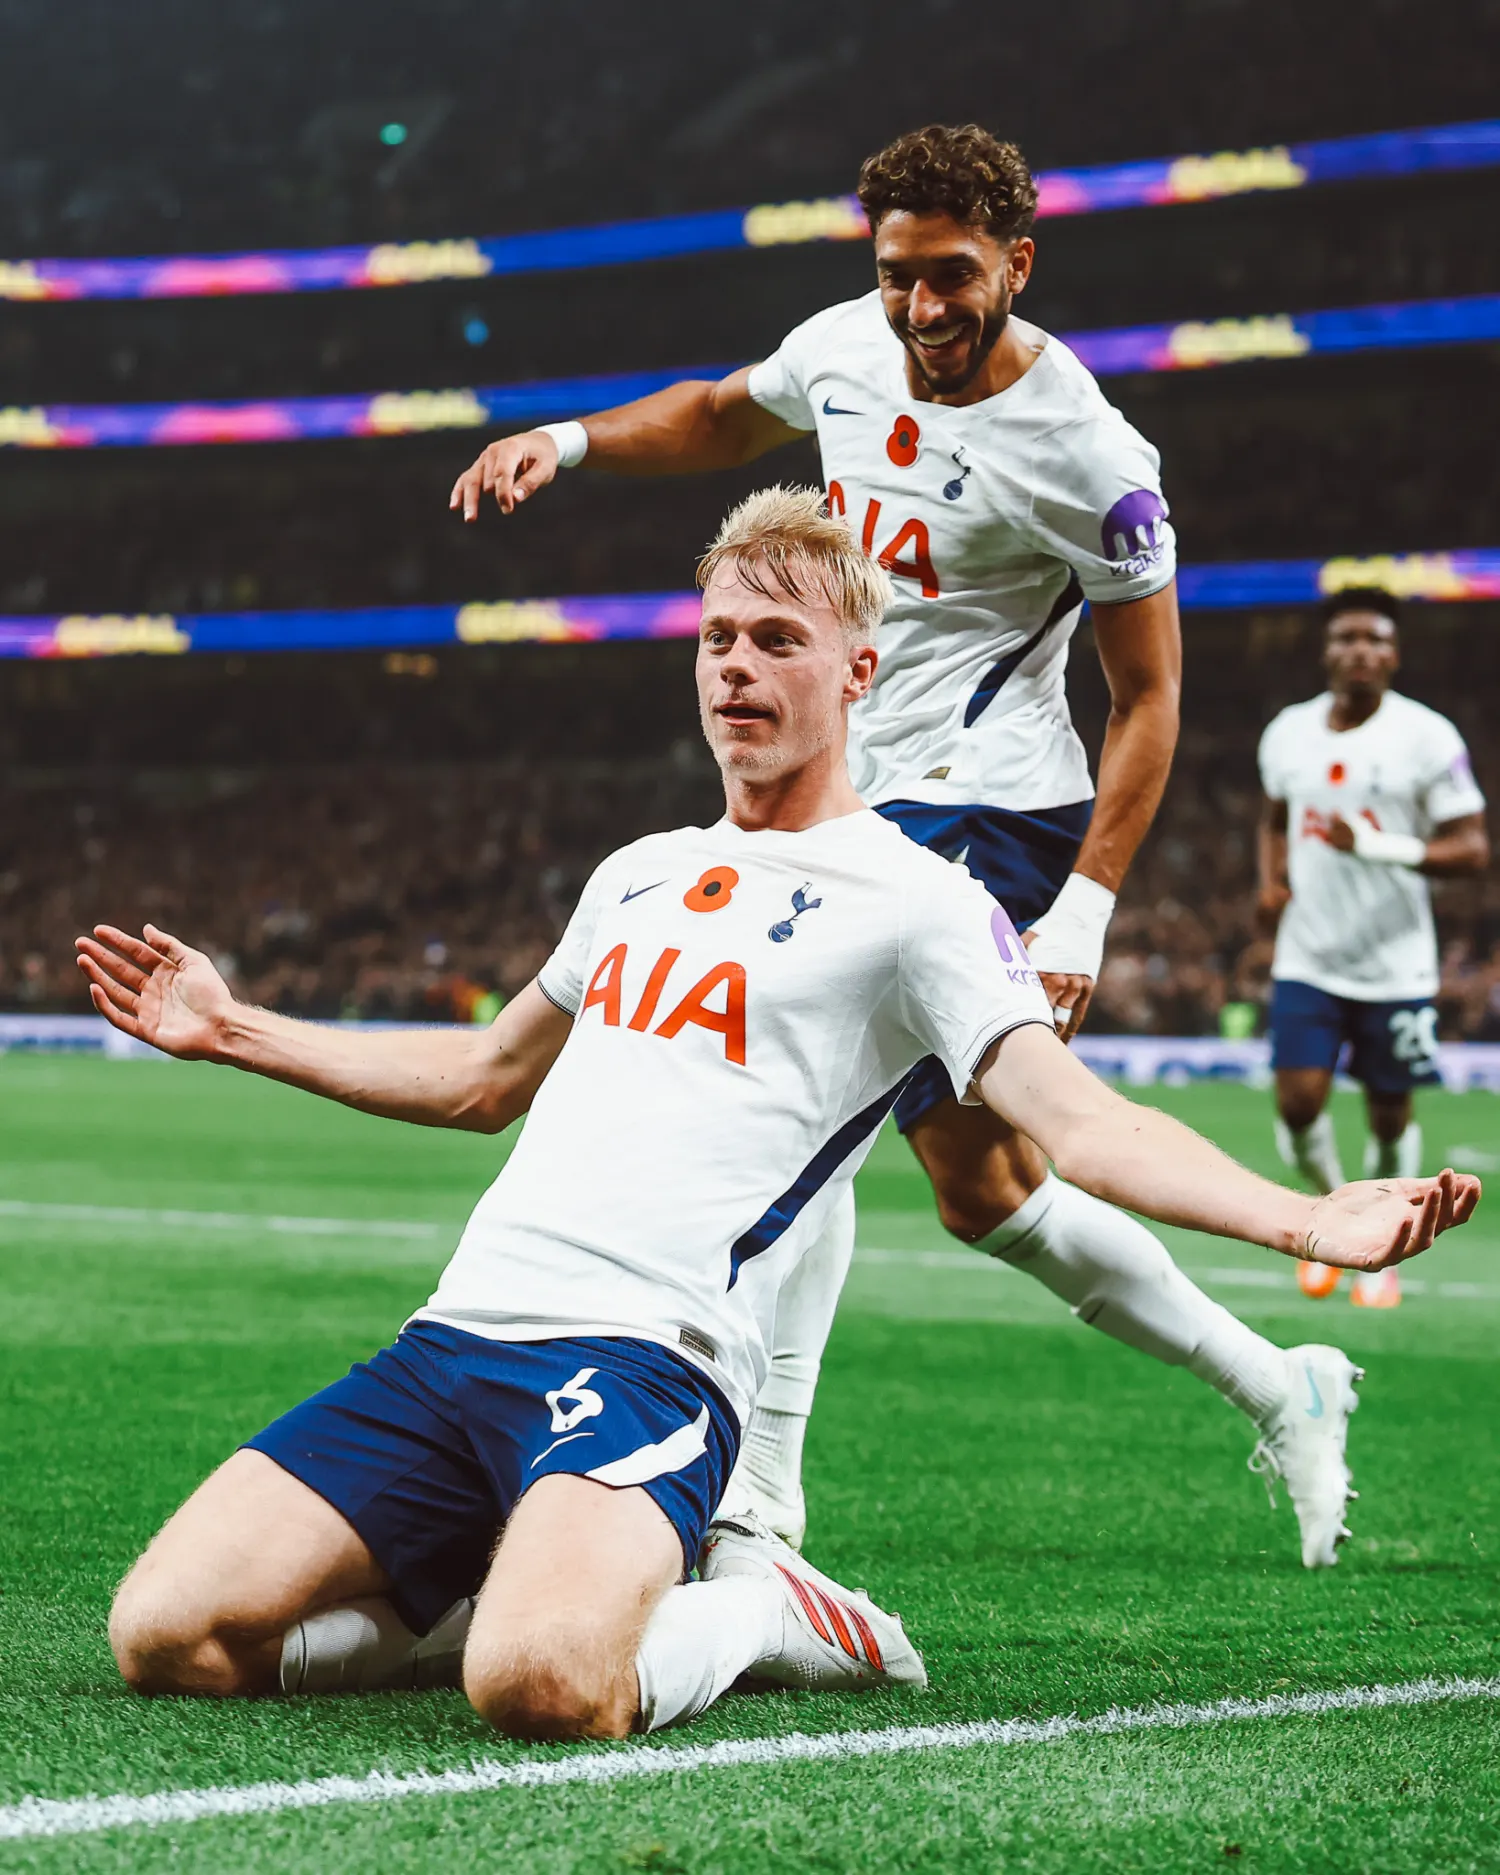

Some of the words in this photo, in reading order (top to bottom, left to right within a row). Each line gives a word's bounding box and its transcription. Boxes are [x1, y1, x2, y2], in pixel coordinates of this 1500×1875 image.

[1110, 543, 1164, 577] krake
[576, 943, 746, 1066] AIA
[545, 1367, 604, 1433] 6
